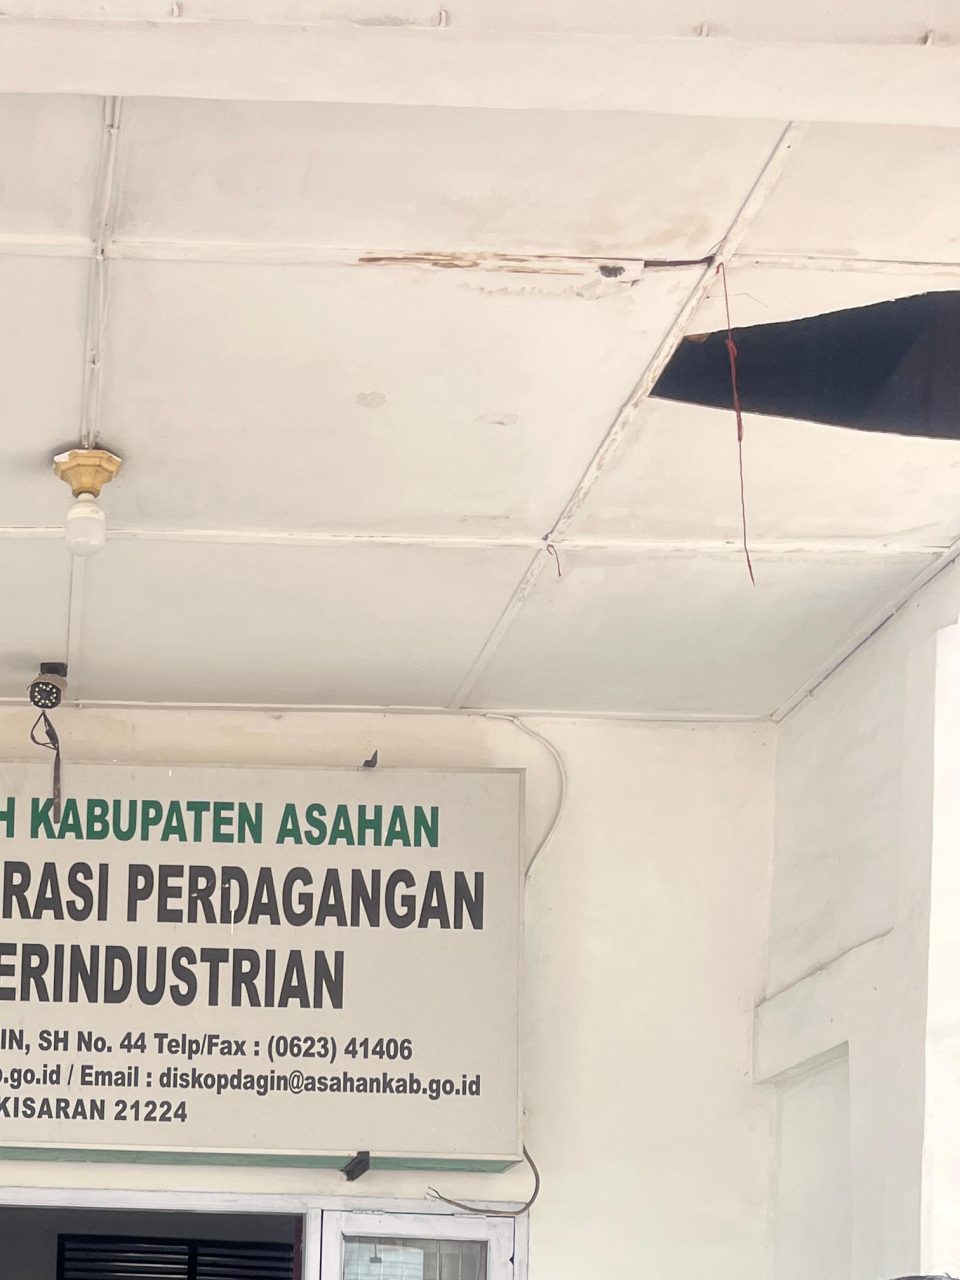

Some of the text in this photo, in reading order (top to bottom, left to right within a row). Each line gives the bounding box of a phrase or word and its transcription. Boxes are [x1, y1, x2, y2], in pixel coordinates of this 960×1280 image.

[31, 797, 263, 843] KABUPATEN
[276, 803, 439, 847] ASAHAN
[127, 864, 484, 929] PERDAGANGAN
[38, 1030, 68, 1051] SH
[77, 1031, 112, 1052] No.
[120, 1032, 146, 1053] 44
[154, 1033, 246, 1060] Telp/Fax
[268, 1035, 336, 1064] (0623)
[344, 1038, 412, 1060] 41406
[81, 1065, 139, 1087] Email
[159, 1067, 480, 1101] diskopdagin@asahankab.go.id
[114, 1100, 187, 1122] 21224
